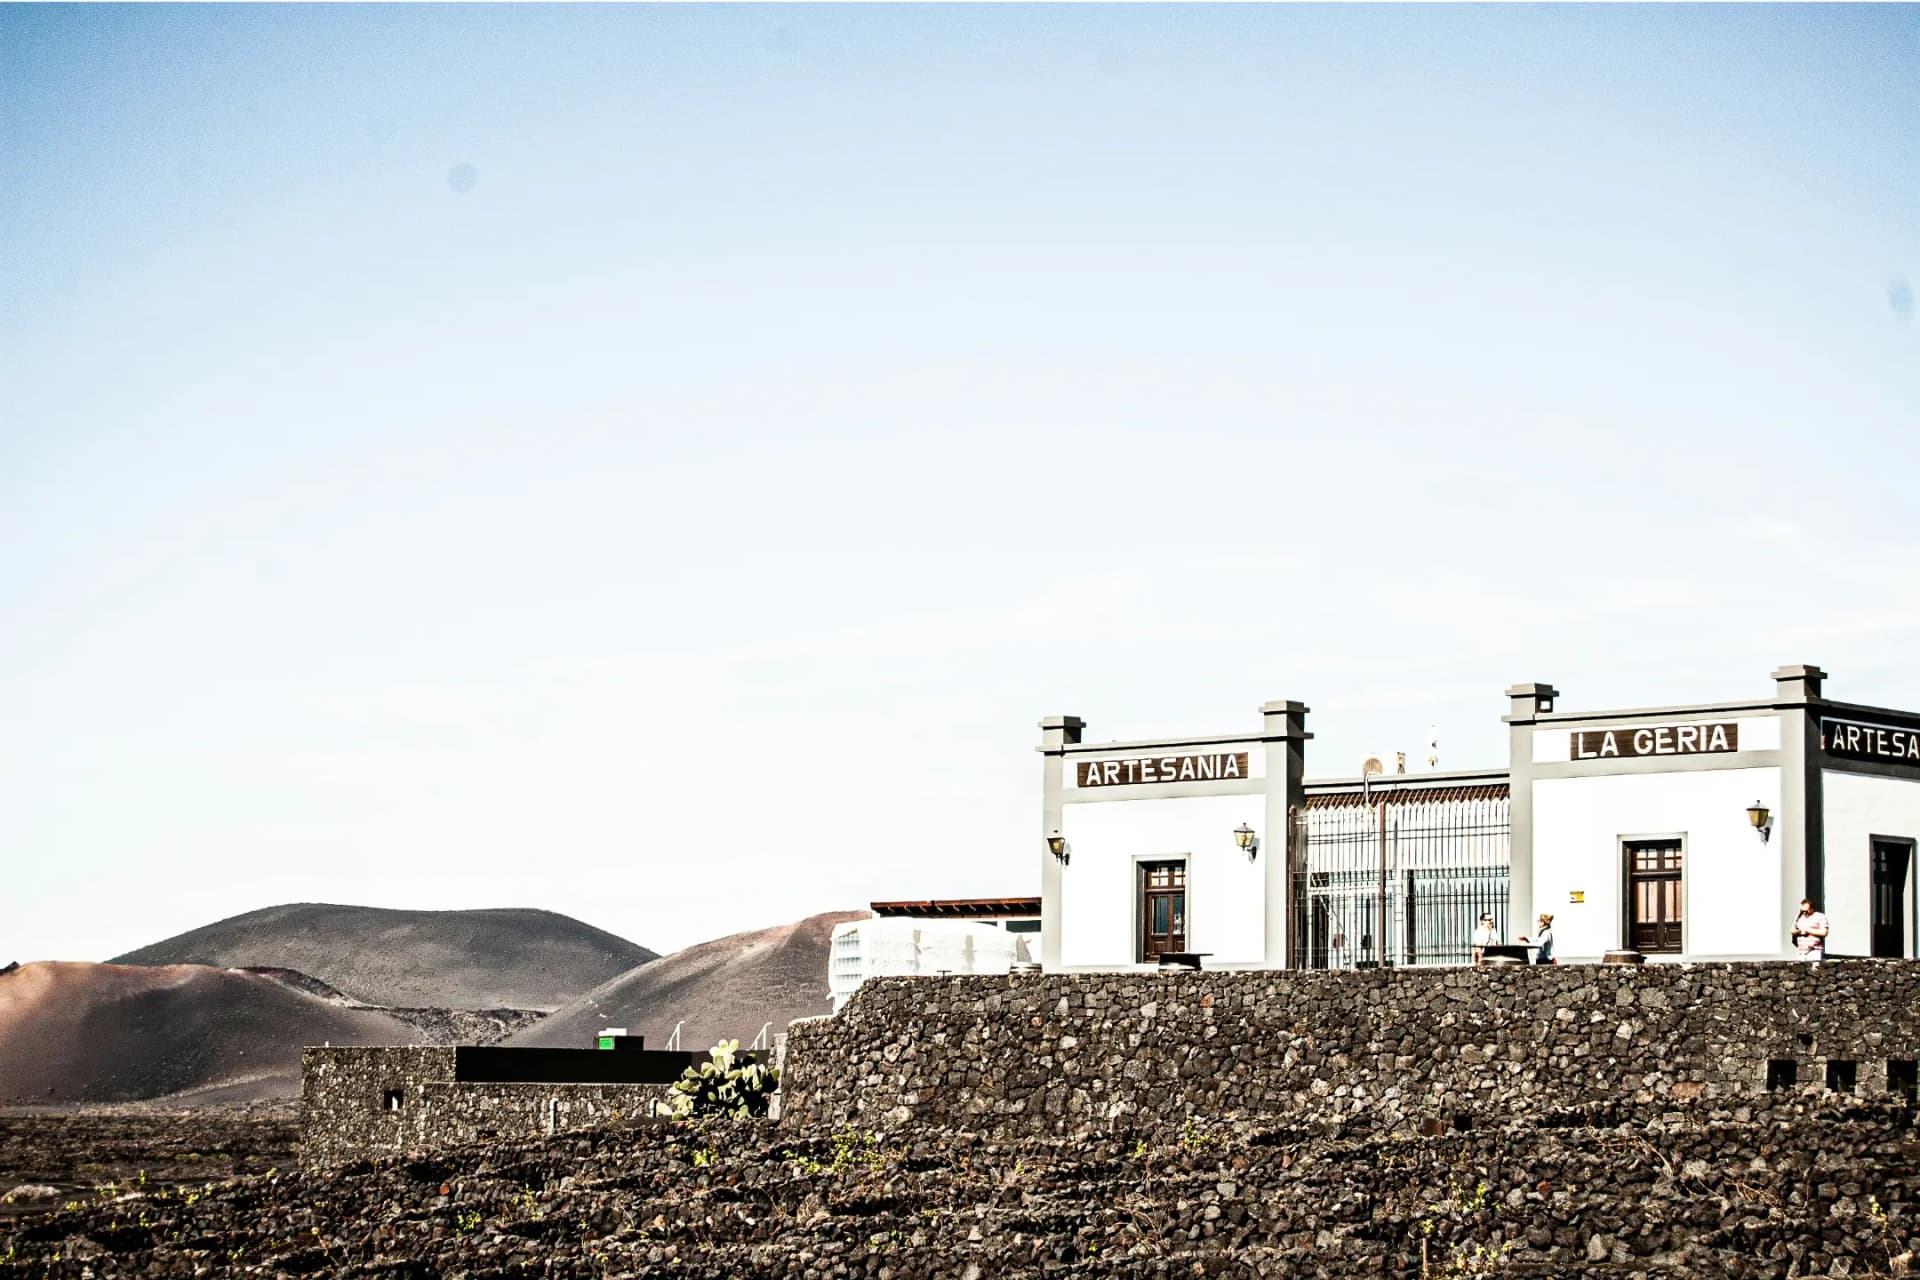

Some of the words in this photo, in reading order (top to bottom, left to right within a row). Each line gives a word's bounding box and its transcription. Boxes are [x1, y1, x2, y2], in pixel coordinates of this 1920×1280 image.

[1578, 731, 1619, 758] LA
[1633, 725, 1729, 754] GERIA
[1832, 724, 1920, 759] ARTESA
[1086, 754, 1240, 785] ARTESANIA
